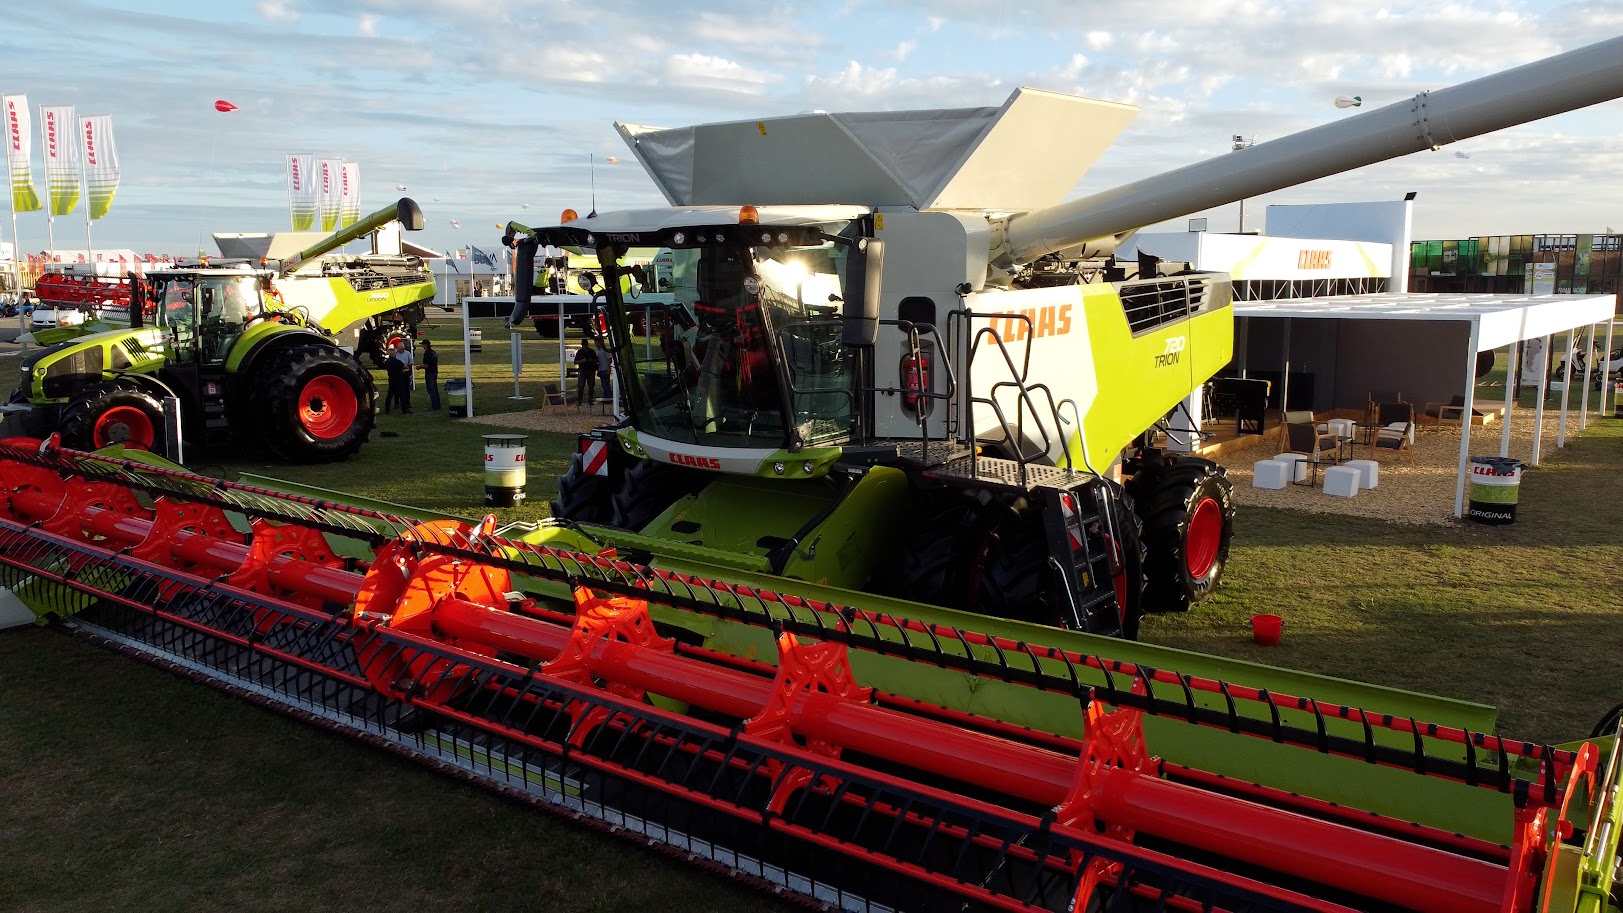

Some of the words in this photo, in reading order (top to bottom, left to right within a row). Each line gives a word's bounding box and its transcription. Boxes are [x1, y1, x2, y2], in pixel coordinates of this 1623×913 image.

[8, 100, 20, 150] CLAAS
[47, 111, 56, 157] CLAAS
[85, 121, 96, 165] CLAAS
[292, 157, 300, 191] CLAAS
[606, 233, 640, 243] TRION
[1297, 249, 1332, 270] CLAAS
[987, 304, 1073, 345] CLAAS
[1164, 335, 1186, 354] 720
[1154, 351, 1181, 369] TRION
[669, 452, 720, 469] CLAAS
[1470, 509, 1512, 519] ORIGINAL
